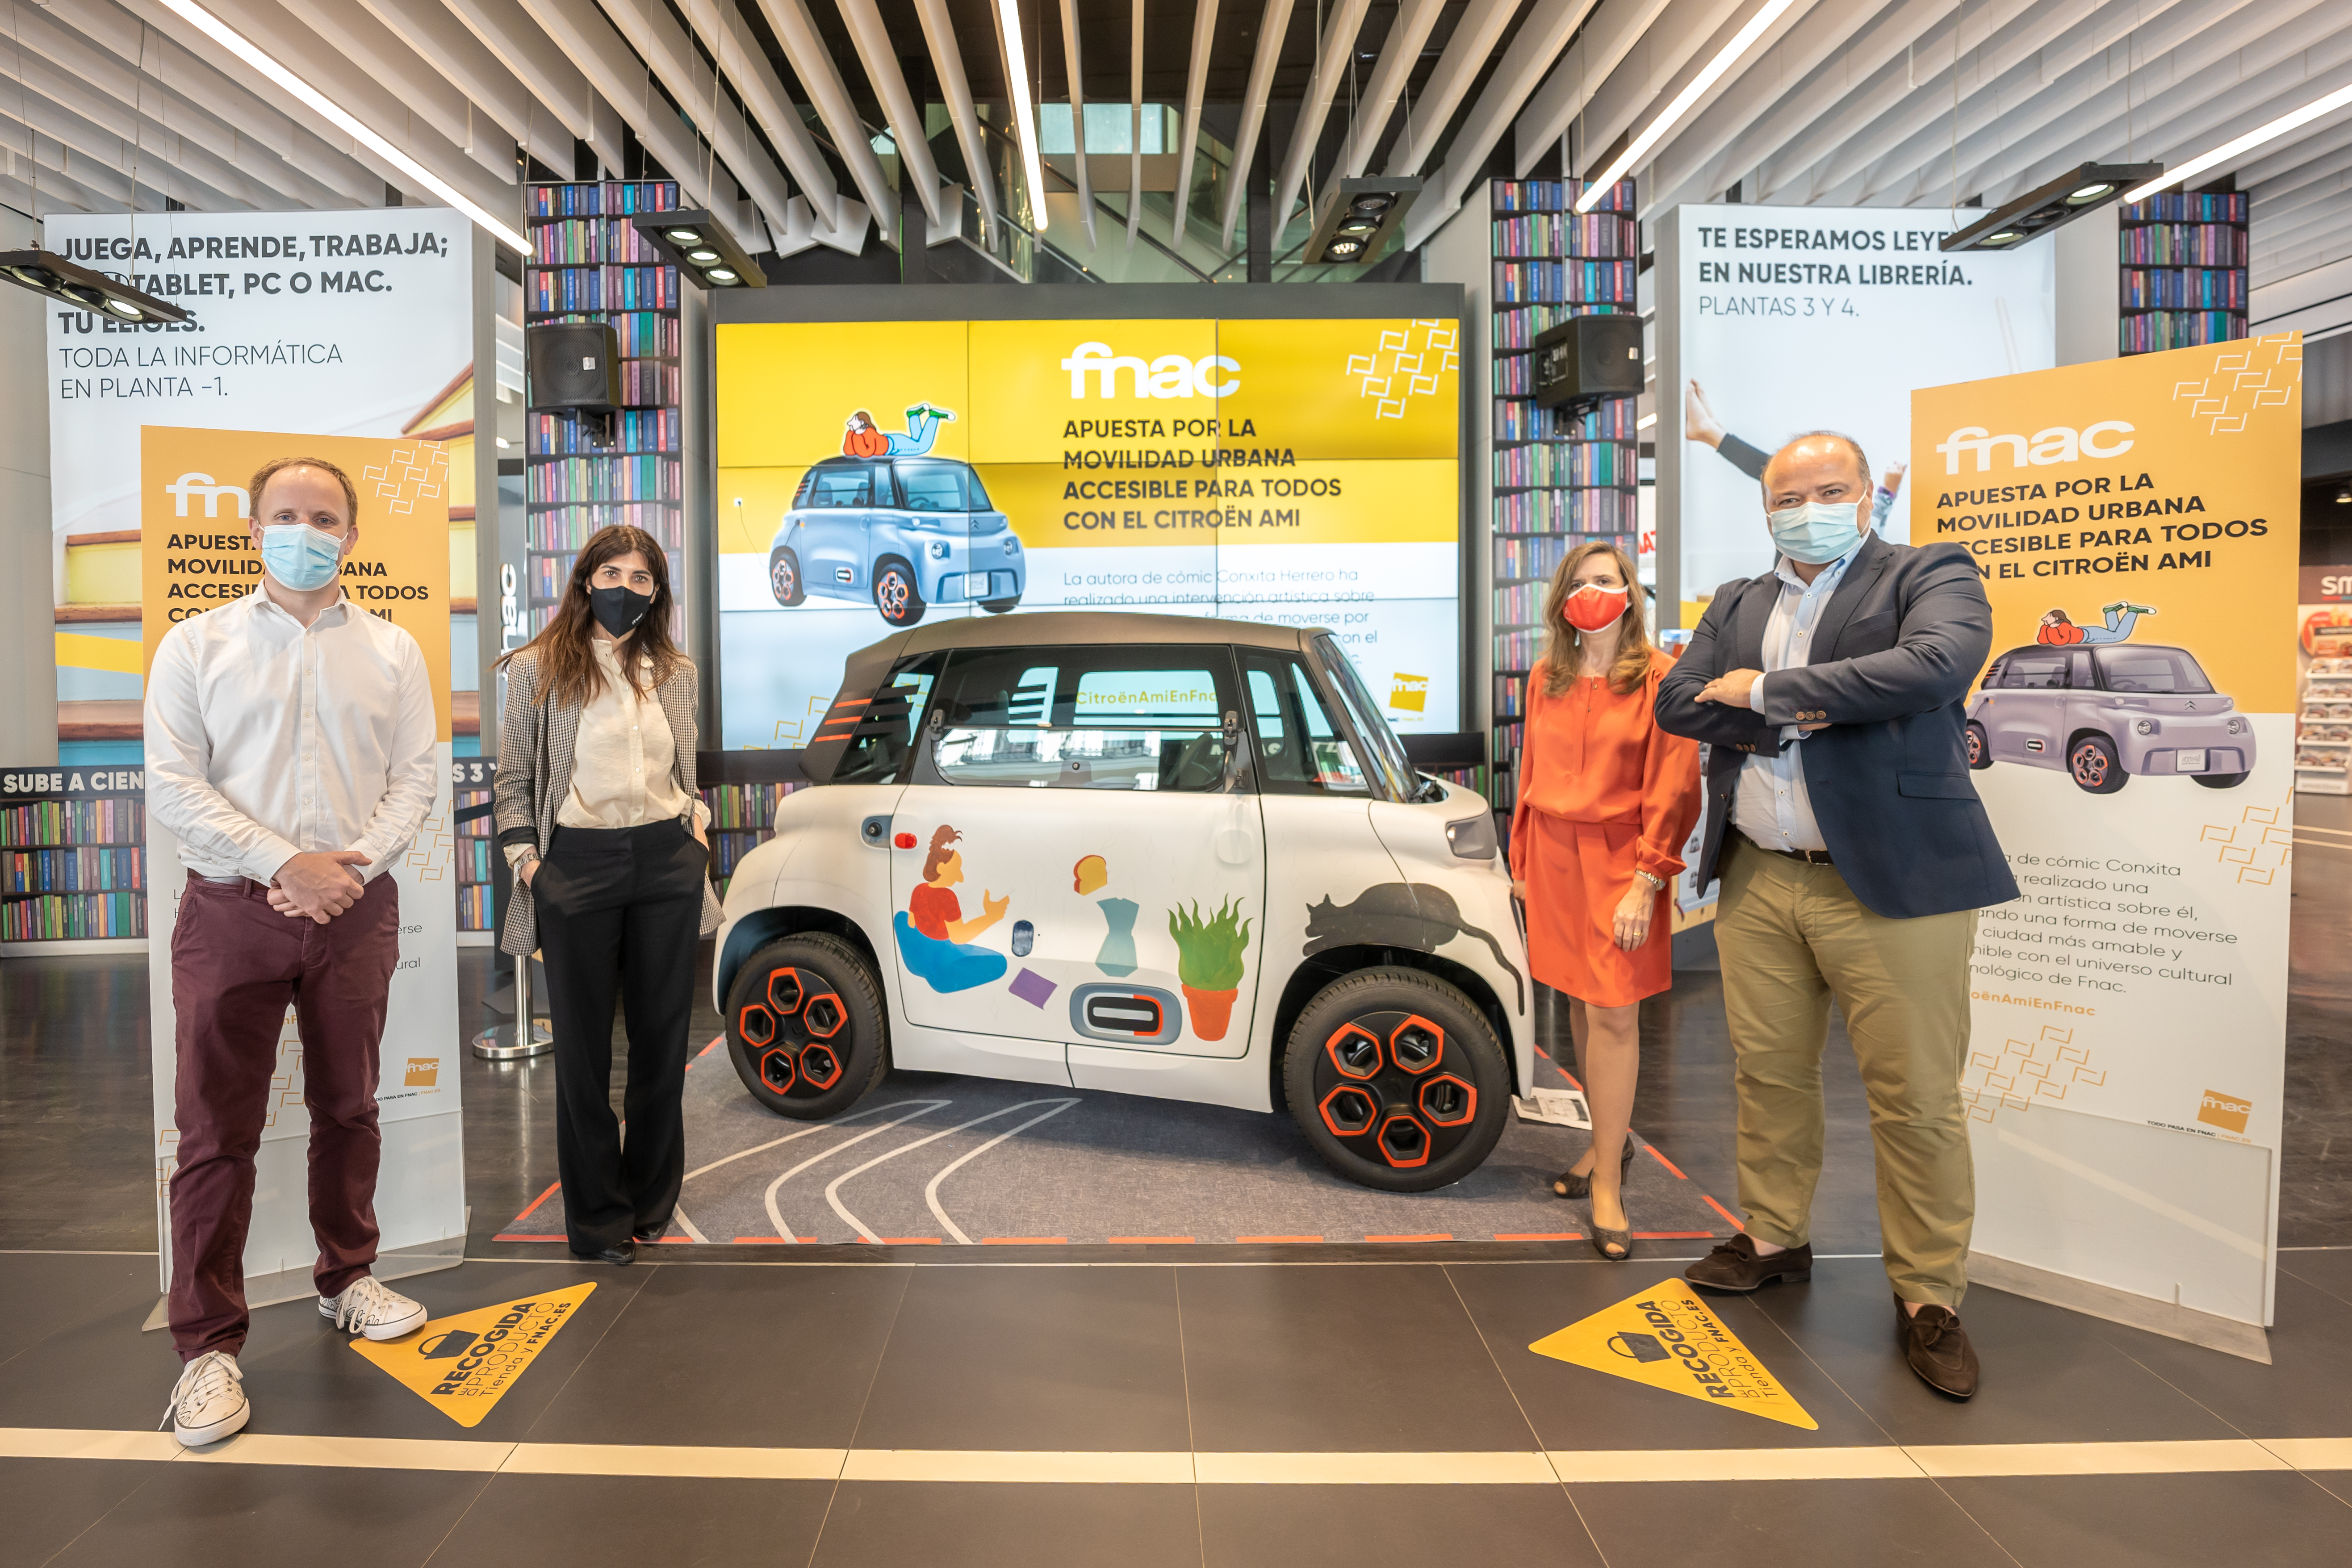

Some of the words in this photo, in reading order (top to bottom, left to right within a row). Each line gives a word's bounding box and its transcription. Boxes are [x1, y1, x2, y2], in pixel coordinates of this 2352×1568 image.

[60, 238, 161, 263] JUEGA,
[167, 235, 305, 263] APRENDE,
[309, 231, 448, 259] TRABAJA;
[1698, 227, 1727, 248] TE
[1734, 228, 1886, 251] ESPERAMOS
[1894, 230, 1956, 251] LEYE
[132, 273, 234, 299] TABLET,
[244, 272, 281, 295] PC
[289, 271, 312, 294] O
[321, 269, 393, 294] MAC.
[1699, 261, 1730, 283] EN
[1738, 262, 1851, 285] NUESTRA
[1859, 259, 1973, 286] LIBRERÍA.
[1699, 296, 1796, 317] PLANTAS
[1804, 297, 1815, 317] 3
[1821, 298, 1835, 317] Y
[1841, 297, 1860, 317] 4.
[59, 347, 129, 368] TODA
[138, 345, 166, 367] LA
[174, 339, 343, 367] INFORMÁTICA
[1061, 341, 1241, 399] fnac
[62, 378, 91, 399] EN
[100, 377, 193, 398] PLANTA
[1063, 419, 1165, 438] APUESTA
[1173, 418, 1222, 437] POR
[1228, 418, 1257, 437] LA
[1063, 450, 1194, 469] MOVILIDAD
[1201, 448, 1297, 468] URBANA
[1936, 420, 2135, 475] fnac
[166, 472, 250, 518] fn
[1063, 480, 1188, 500] ACCESIBLE
[1194, 479, 1255, 499] PARA
[1261, 478, 1342, 498] TODOS
[1936, 483, 2047, 509] APUESTA
[2055, 476, 2111, 498] POR
[2120, 472, 2155, 492] LA
[1063, 510, 1115, 530] CON
[1123, 510, 1147, 529] EL
[1154, 505, 1252, 528] CITROËN
[1259, 508, 1300, 527] AMI
[1937, 506, 2080, 534] MOVILIDAD
[2088, 495, 2206, 521] URBANA
[1958, 531, 2071, 556] CESIBLE
[2080, 526, 2153, 549] PARA
[2160, 518, 2268, 544] TODOS
[168, 558, 266, 575] MOVILID
[339, 562, 388, 577] ANA
[2000, 562, 2026, 579] EL
[2032, 552, 2149, 577] CITROËN
[2156, 550, 2212, 570] AMI
[1064, 572, 1082, 585] La
[1086, 573, 1137, 585] autora
[1142, 571, 1162, 584] de
[1167, 570, 1213, 584] cómic
[1217, 569, 1275, 582] Conxita
[1280, 569, 1335, 581] Herrero
[1339, 569, 1358, 581] ha
[167, 583, 258, 599] ACCESI
[356, 585, 429, 600] TODOS
[1064, 593, 1134, 605] realizado
[1138, 595, 1168, 603] una
[1173, 590, 1264, 604] intervención
[1268, 590, 1329, 602] artística
[1334, 589, 1375, 602] sobre
[168, 607, 210, 623] CO
[370, 609, 392, 623] MI
[499, 564, 517, 674] nac
[1278, 613, 1340, 624] moverse
[1344, 612, 1369, 626] por
[1365, 630, 1377, 643] el
[1392, 677, 1428, 692] fnac
[1076, 690, 1217, 705] CitroënAmiEnFna
[3, 773, 63, 793] SUBE
[68, 772, 85, 791] A
[90, 771, 145, 791] CIEN
[2017, 853, 2040, 865] de
[2046, 856, 2100, 870] cómic
[2106, 859, 2180, 876] Conxita
[2024, 874, 2107, 891] realizado
[2113, 882, 2148, 894] una
[2038, 894, 2111, 911] artística
[2117, 902, 2171, 916] sobre
[2177, 906, 2198, 921] él,
[397, 924, 423, 935] erse
[2024, 914, 2057, 925] una
[2063, 915, 2116, 931] forma
[2122, 922, 2147, 934] de
[2154, 927, 2238, 944] moverse
[1982, 927, 2042, 943] ciudad
[2048, 935, 2086, 948] más
[2092, 941, 2165, 957] amable
[2171, 949, 2183, 961] y
[396, 957, 421, 970] ural
[1974, 945, 2012, 959] nible
[2017, 951, 2050, 963] con
[2055, 954, 2070, 966] el
[2076, 958, 2152, 976] universo
[2158, 968, 2232, 985] cultural
[1969, 964, 2043, 981] nológico
[2048, 973, 2072, 985] de
[2078, 975, 2126, 993] Fnac.
[1971, 990, 2096, 1016] oënAmiEnFnac
[406, 1062, 439, 1073] fnac
[2201, 1096, 2251, 1114] fnac
[2167, 1123, 2185, 1132] PASA
[1681, 1299, 1730, 1342] FNAC.ES
[429, 1302, 537, 1395] RECOGIDA
[465, 1302, 554, 1386] PRODUCTO
[478, 1357, 524, 1397] Tienda
[526, 1302, 571, 1344] FNAC.ES
[1635, 1300, 1736, 1398] RECOGIDA
[1661, 1300, 1752, 1388] PRODUCTO
[1735, 1357, 1778, 1397] Tienda
